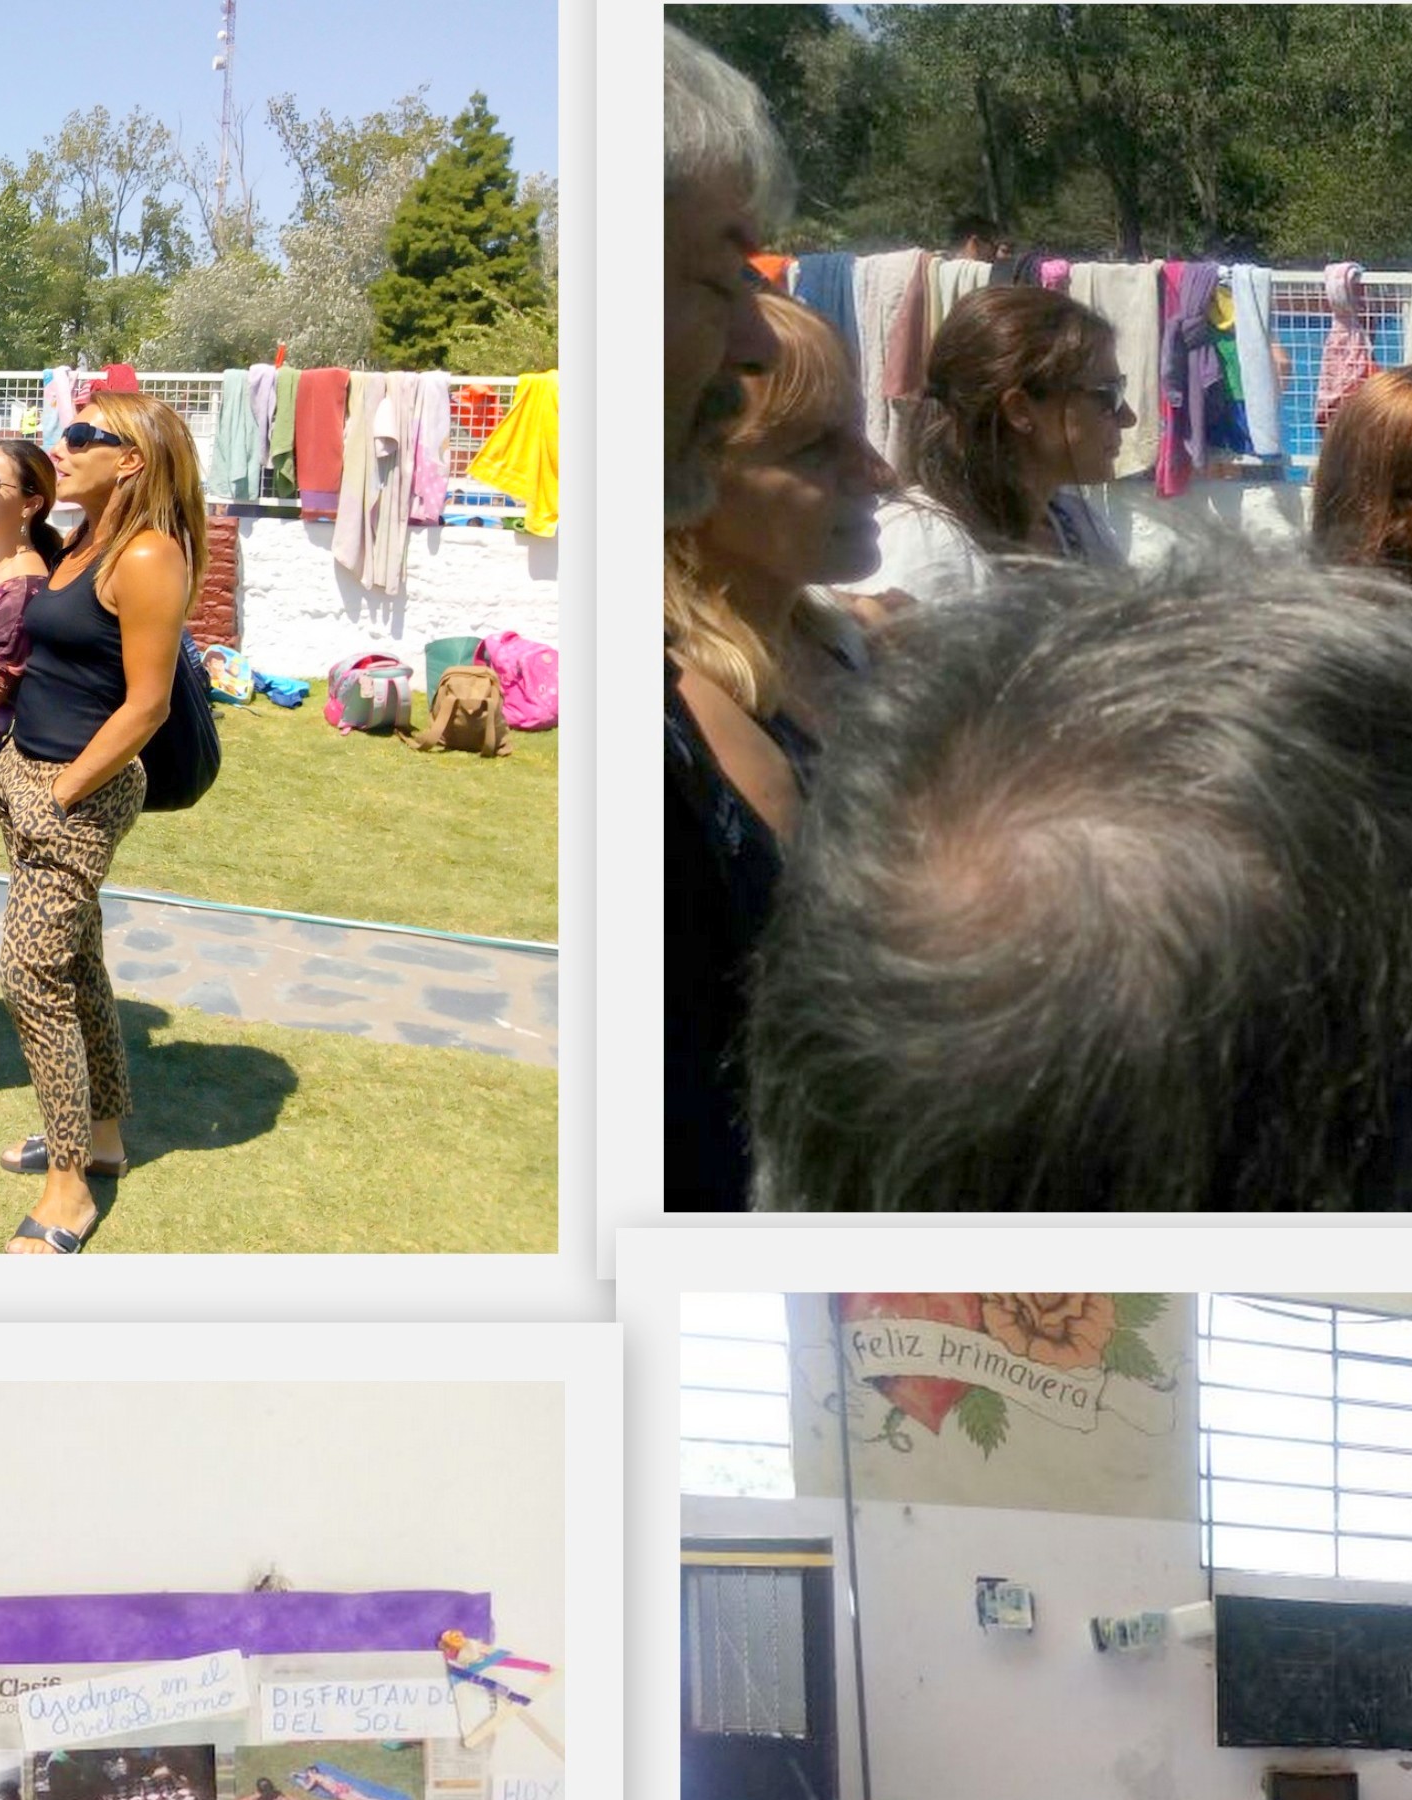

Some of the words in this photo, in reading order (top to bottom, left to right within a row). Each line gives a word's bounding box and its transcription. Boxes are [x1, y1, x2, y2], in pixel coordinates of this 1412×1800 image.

[853, 1328, 925, 1368] feliz
[938, 1333, 1089, 1410] primavera
[161, 1677, 189, 1700] en
[200, 1655, 231, 1688] el
[272, 1710, 325, 1734] DEL
[353, 1706, 412, 1734] SOL
